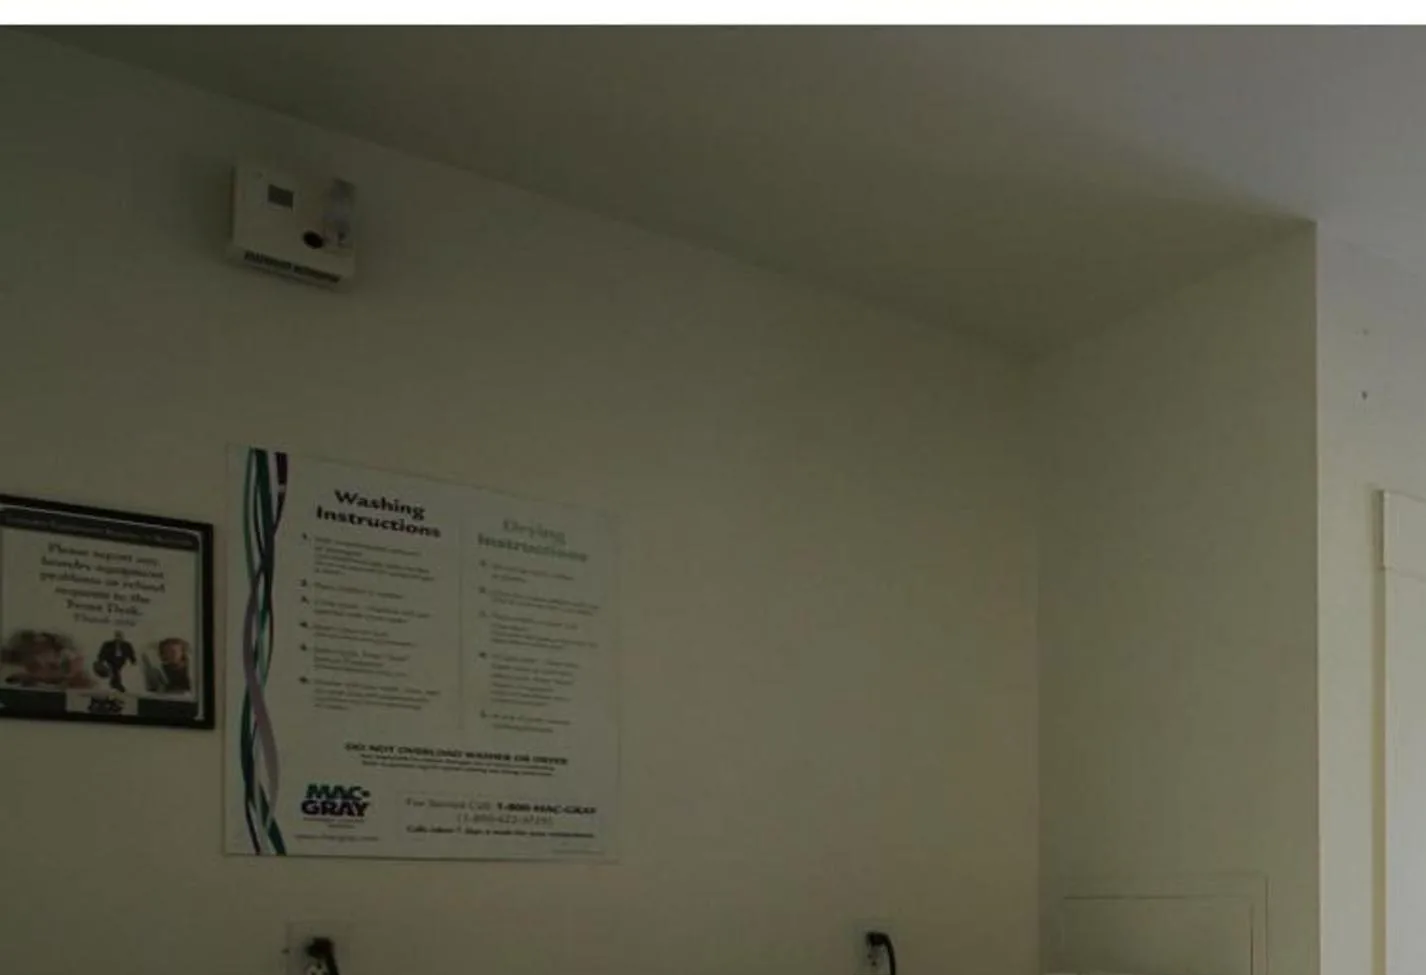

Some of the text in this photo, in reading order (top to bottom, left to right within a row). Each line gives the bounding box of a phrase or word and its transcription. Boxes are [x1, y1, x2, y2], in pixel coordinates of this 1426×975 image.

[334, 489, 425, 521] Washing
[317, 505, 441, 538] Instructions
[301, 800, 370, 817] GRAY
